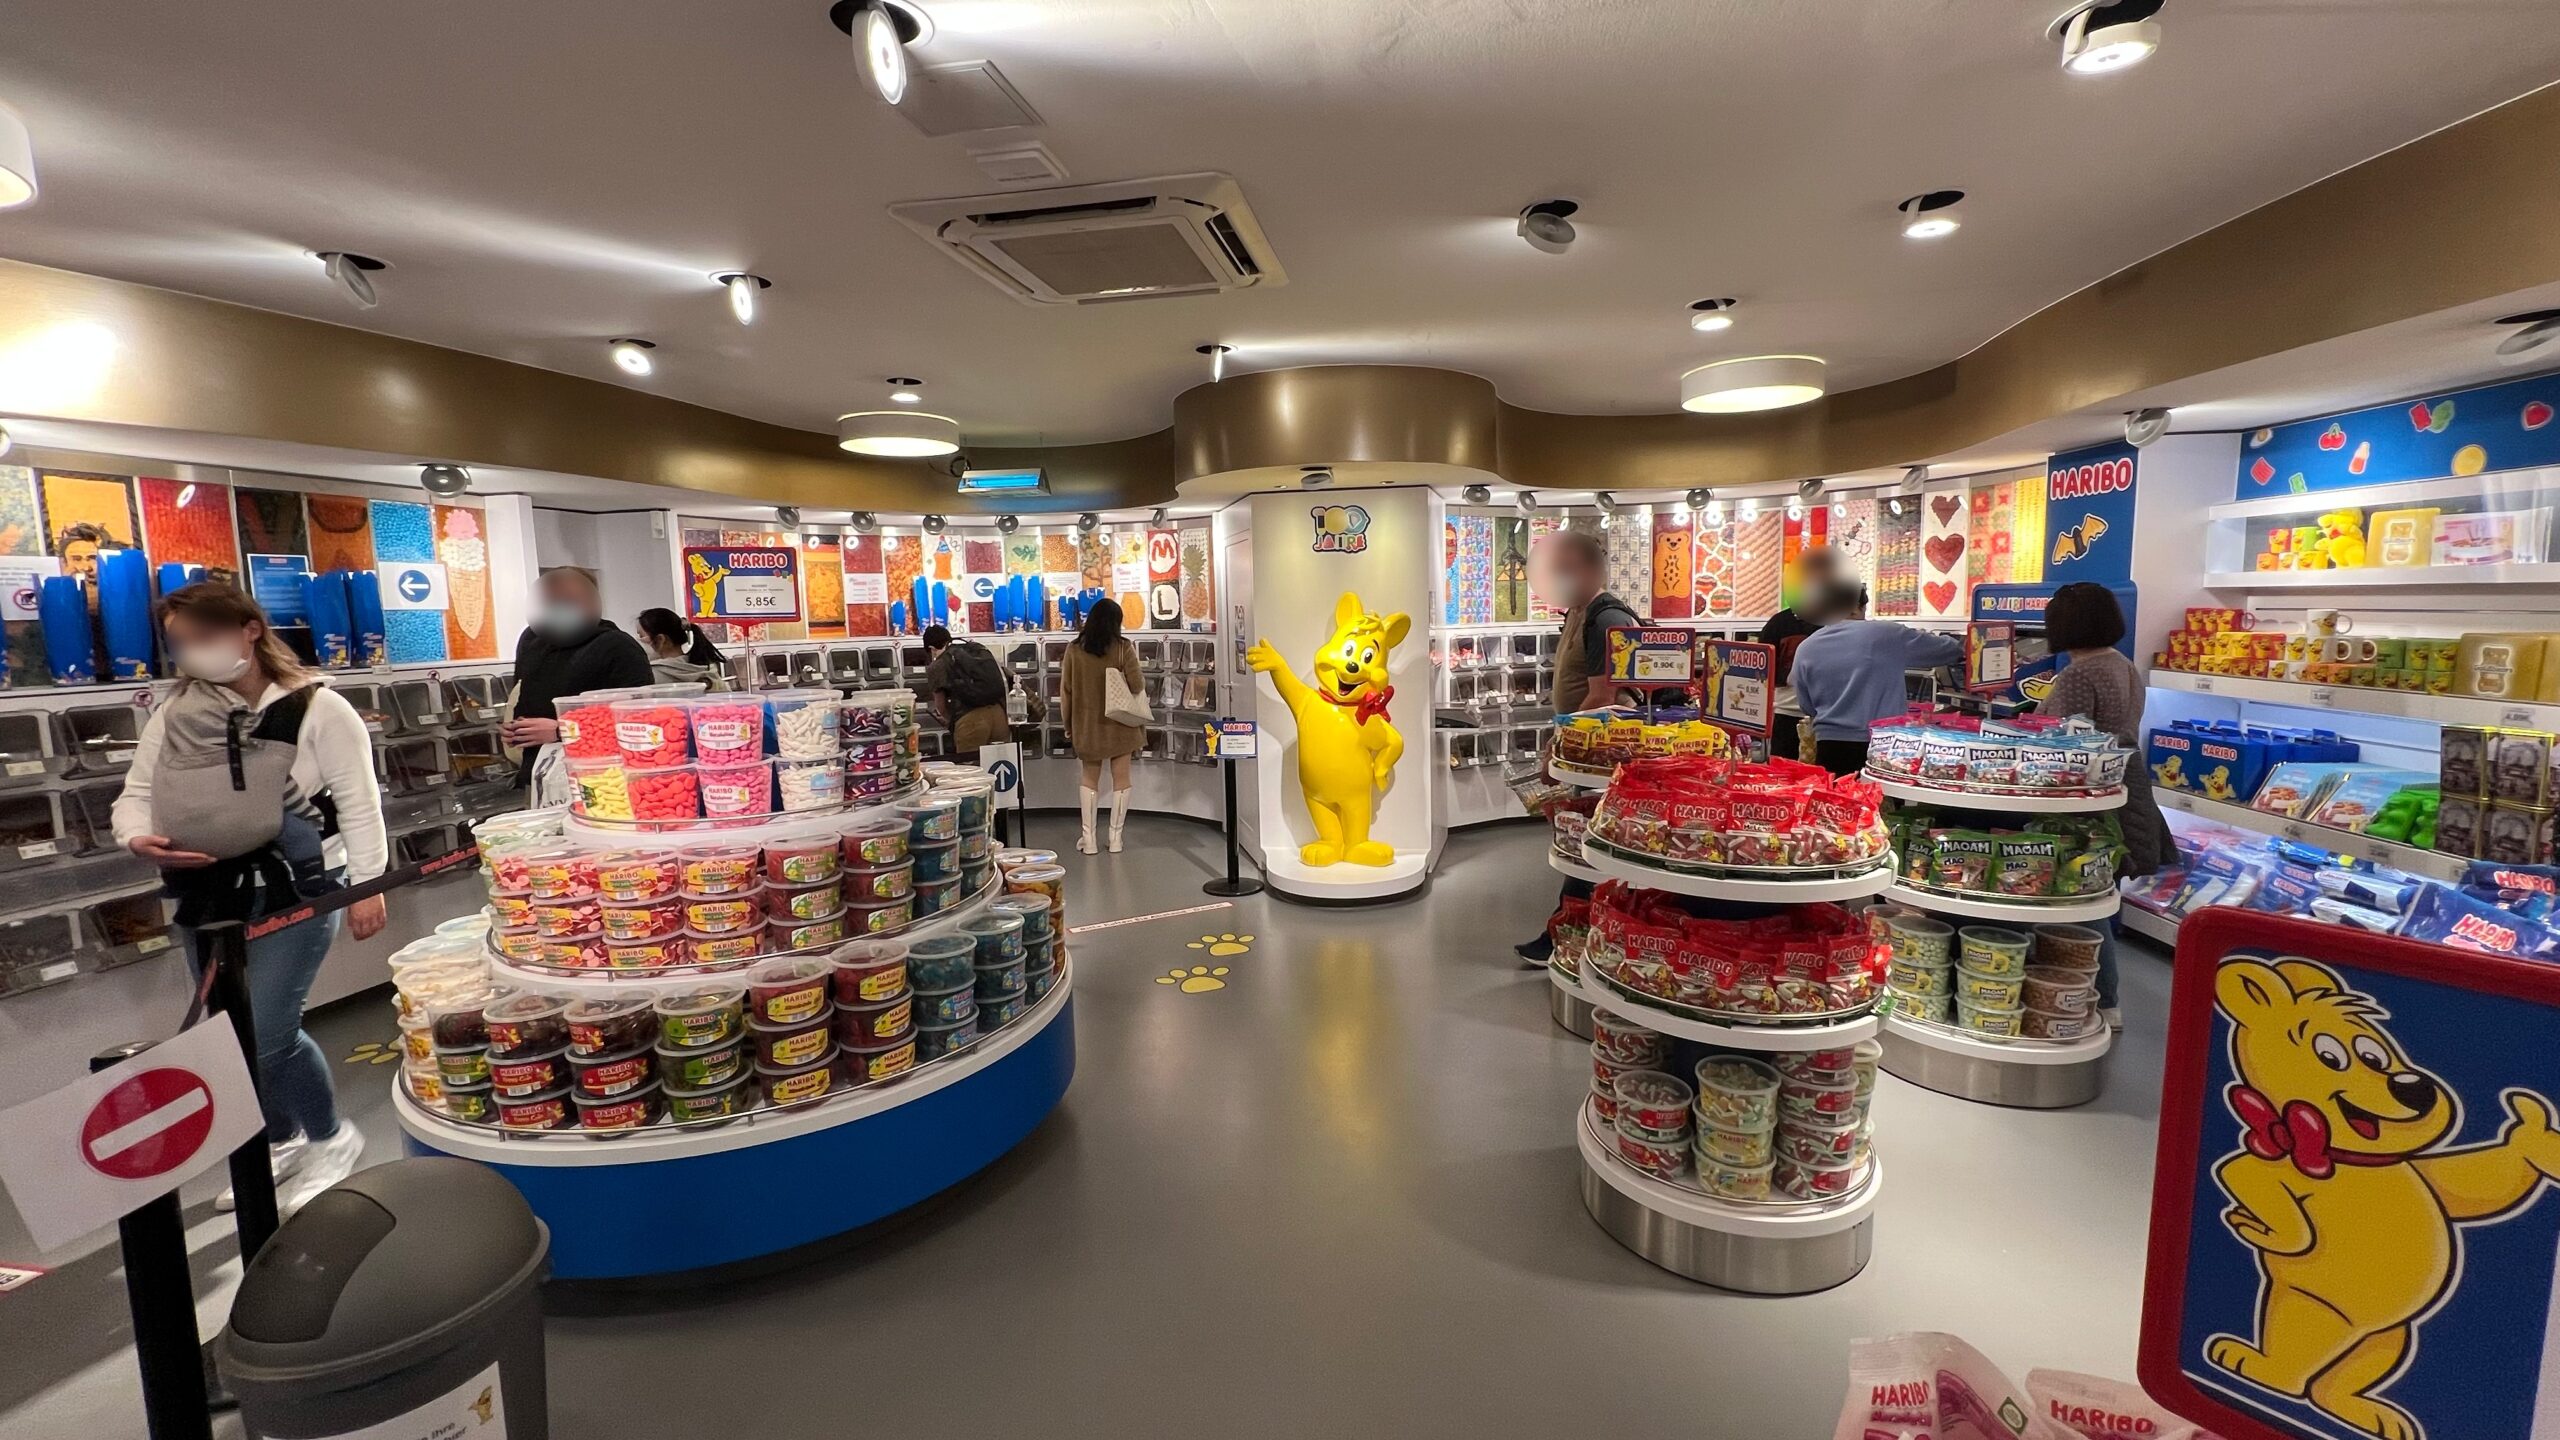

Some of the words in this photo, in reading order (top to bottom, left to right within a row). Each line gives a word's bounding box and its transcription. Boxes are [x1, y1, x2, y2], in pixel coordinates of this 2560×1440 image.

[2050, 457, 2134, 500] HARIBO
[729, 553, 788, 569] HARIBO
[746, 596, 776, 607] 5,85€
[1641, 632, 1688, 645] HARIBO
[1729, 649, 1767, 670] HARIBO
[1607, 727, 1642, 737] HARIBO
[2153, 734, 2190, 751] HARIBO
[1925, 745, 1965, 757] MAOAM
[1972, 749, 2014, 760] MAOAM
[2022, 751, 2065, 763] MAOAM
[2202, 743, 2237, 761] HARIBO
[1675, 803, 1728, 821] HARIBO
[1732, 801, 1790, 821] HARIBO
[1943, 840, 1990, 854] MAOAM
[2002, 844, 2053, 856] MAOAM
[701, 865, 731, 874] HARIBO
[609, 872, 638, 880] HARIBO
[702, 904, 731, 912] HARIBO
[712, 940, 741, 949] HARIBO
[1628, 935, 1677, 953] HARIBO
[617, 949, 644, 957] HARIBO
[783, 991, 813, 1004] HARIBO
[682, 1014, 716, 1026] HARIBO
[789, 1033, 818, 1046] HARIBO
[500, 1066, 533, 1076] HARIBO
[598, 1062, 633, 1076] HARIBO
[787, 1074, 816, 1087] HARIBO
[685, 1097, 717, 1108] HARIBO
[511, 1104, 544, 1116] HARIBO
[594, 1105, 629, 1117] HARIBO
[2051, 1398, 2157, 1434] HARIBO
